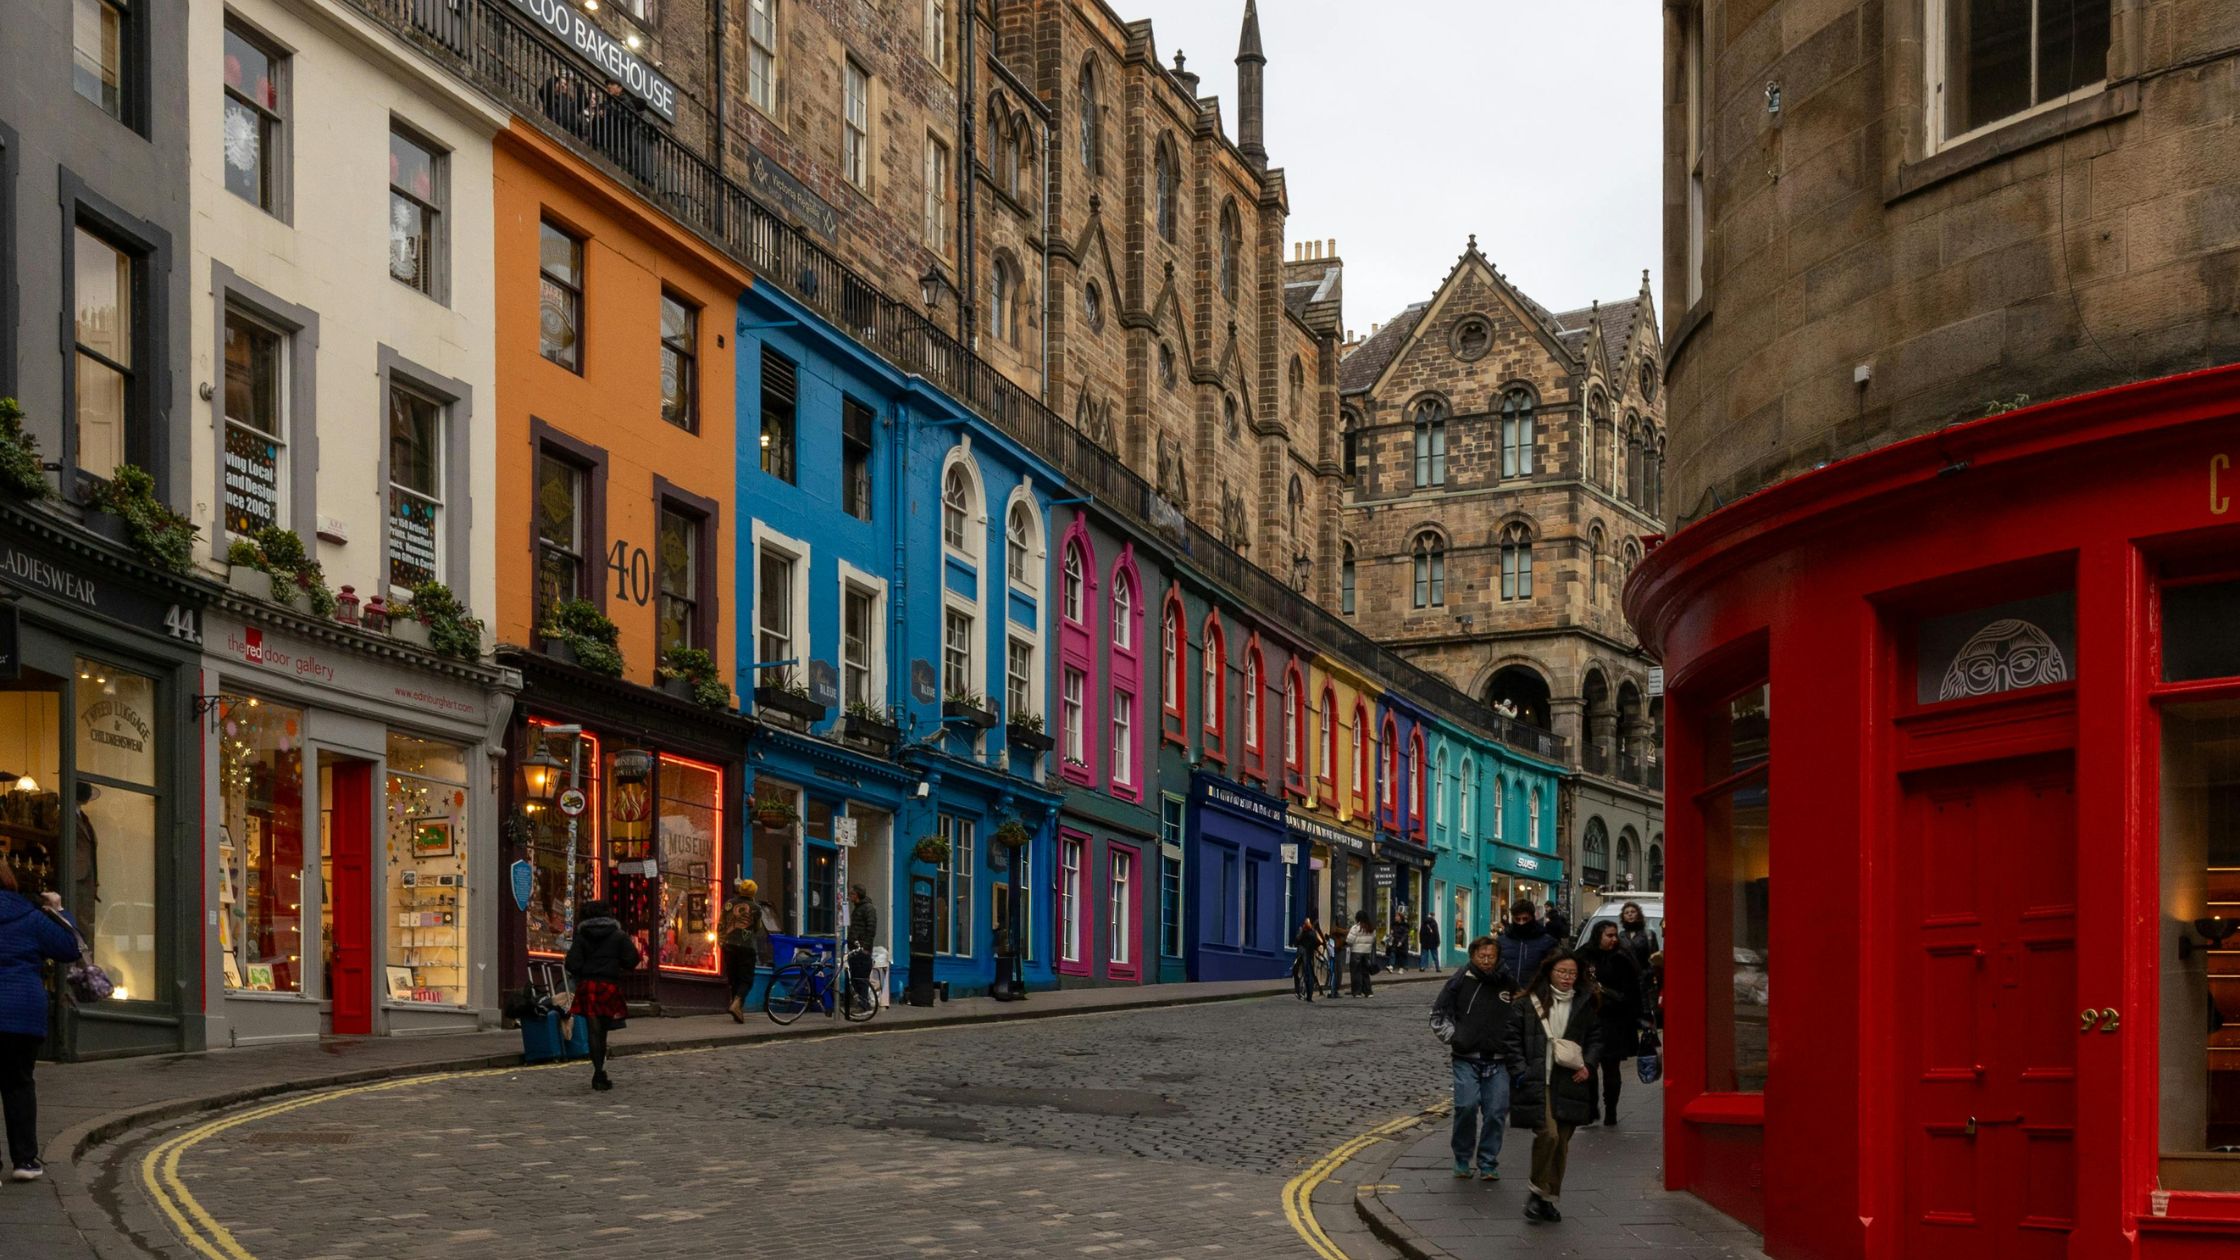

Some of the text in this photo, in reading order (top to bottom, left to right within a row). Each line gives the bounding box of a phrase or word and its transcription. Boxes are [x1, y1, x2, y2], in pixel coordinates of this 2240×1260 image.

[575, 17, 673, 116] BAKEHOUSE
[226, 472, 245, 490] and
[248, 459, 273, 483] Local
[246, 496, 271, 519] 2003
[608, 540, 650, 607] 40
[228, 633, 334, 681] the red door gallery
[81, 700, 151, 743] TWEED LUGGAGE
[90, 728, 143, 753] CHILDRENSWEAR
[668, 832, 714, 863] MUSEUM
[1517, 857, 1539, 871] SWISH
[2080, 1007, 2120, 1031] 92
